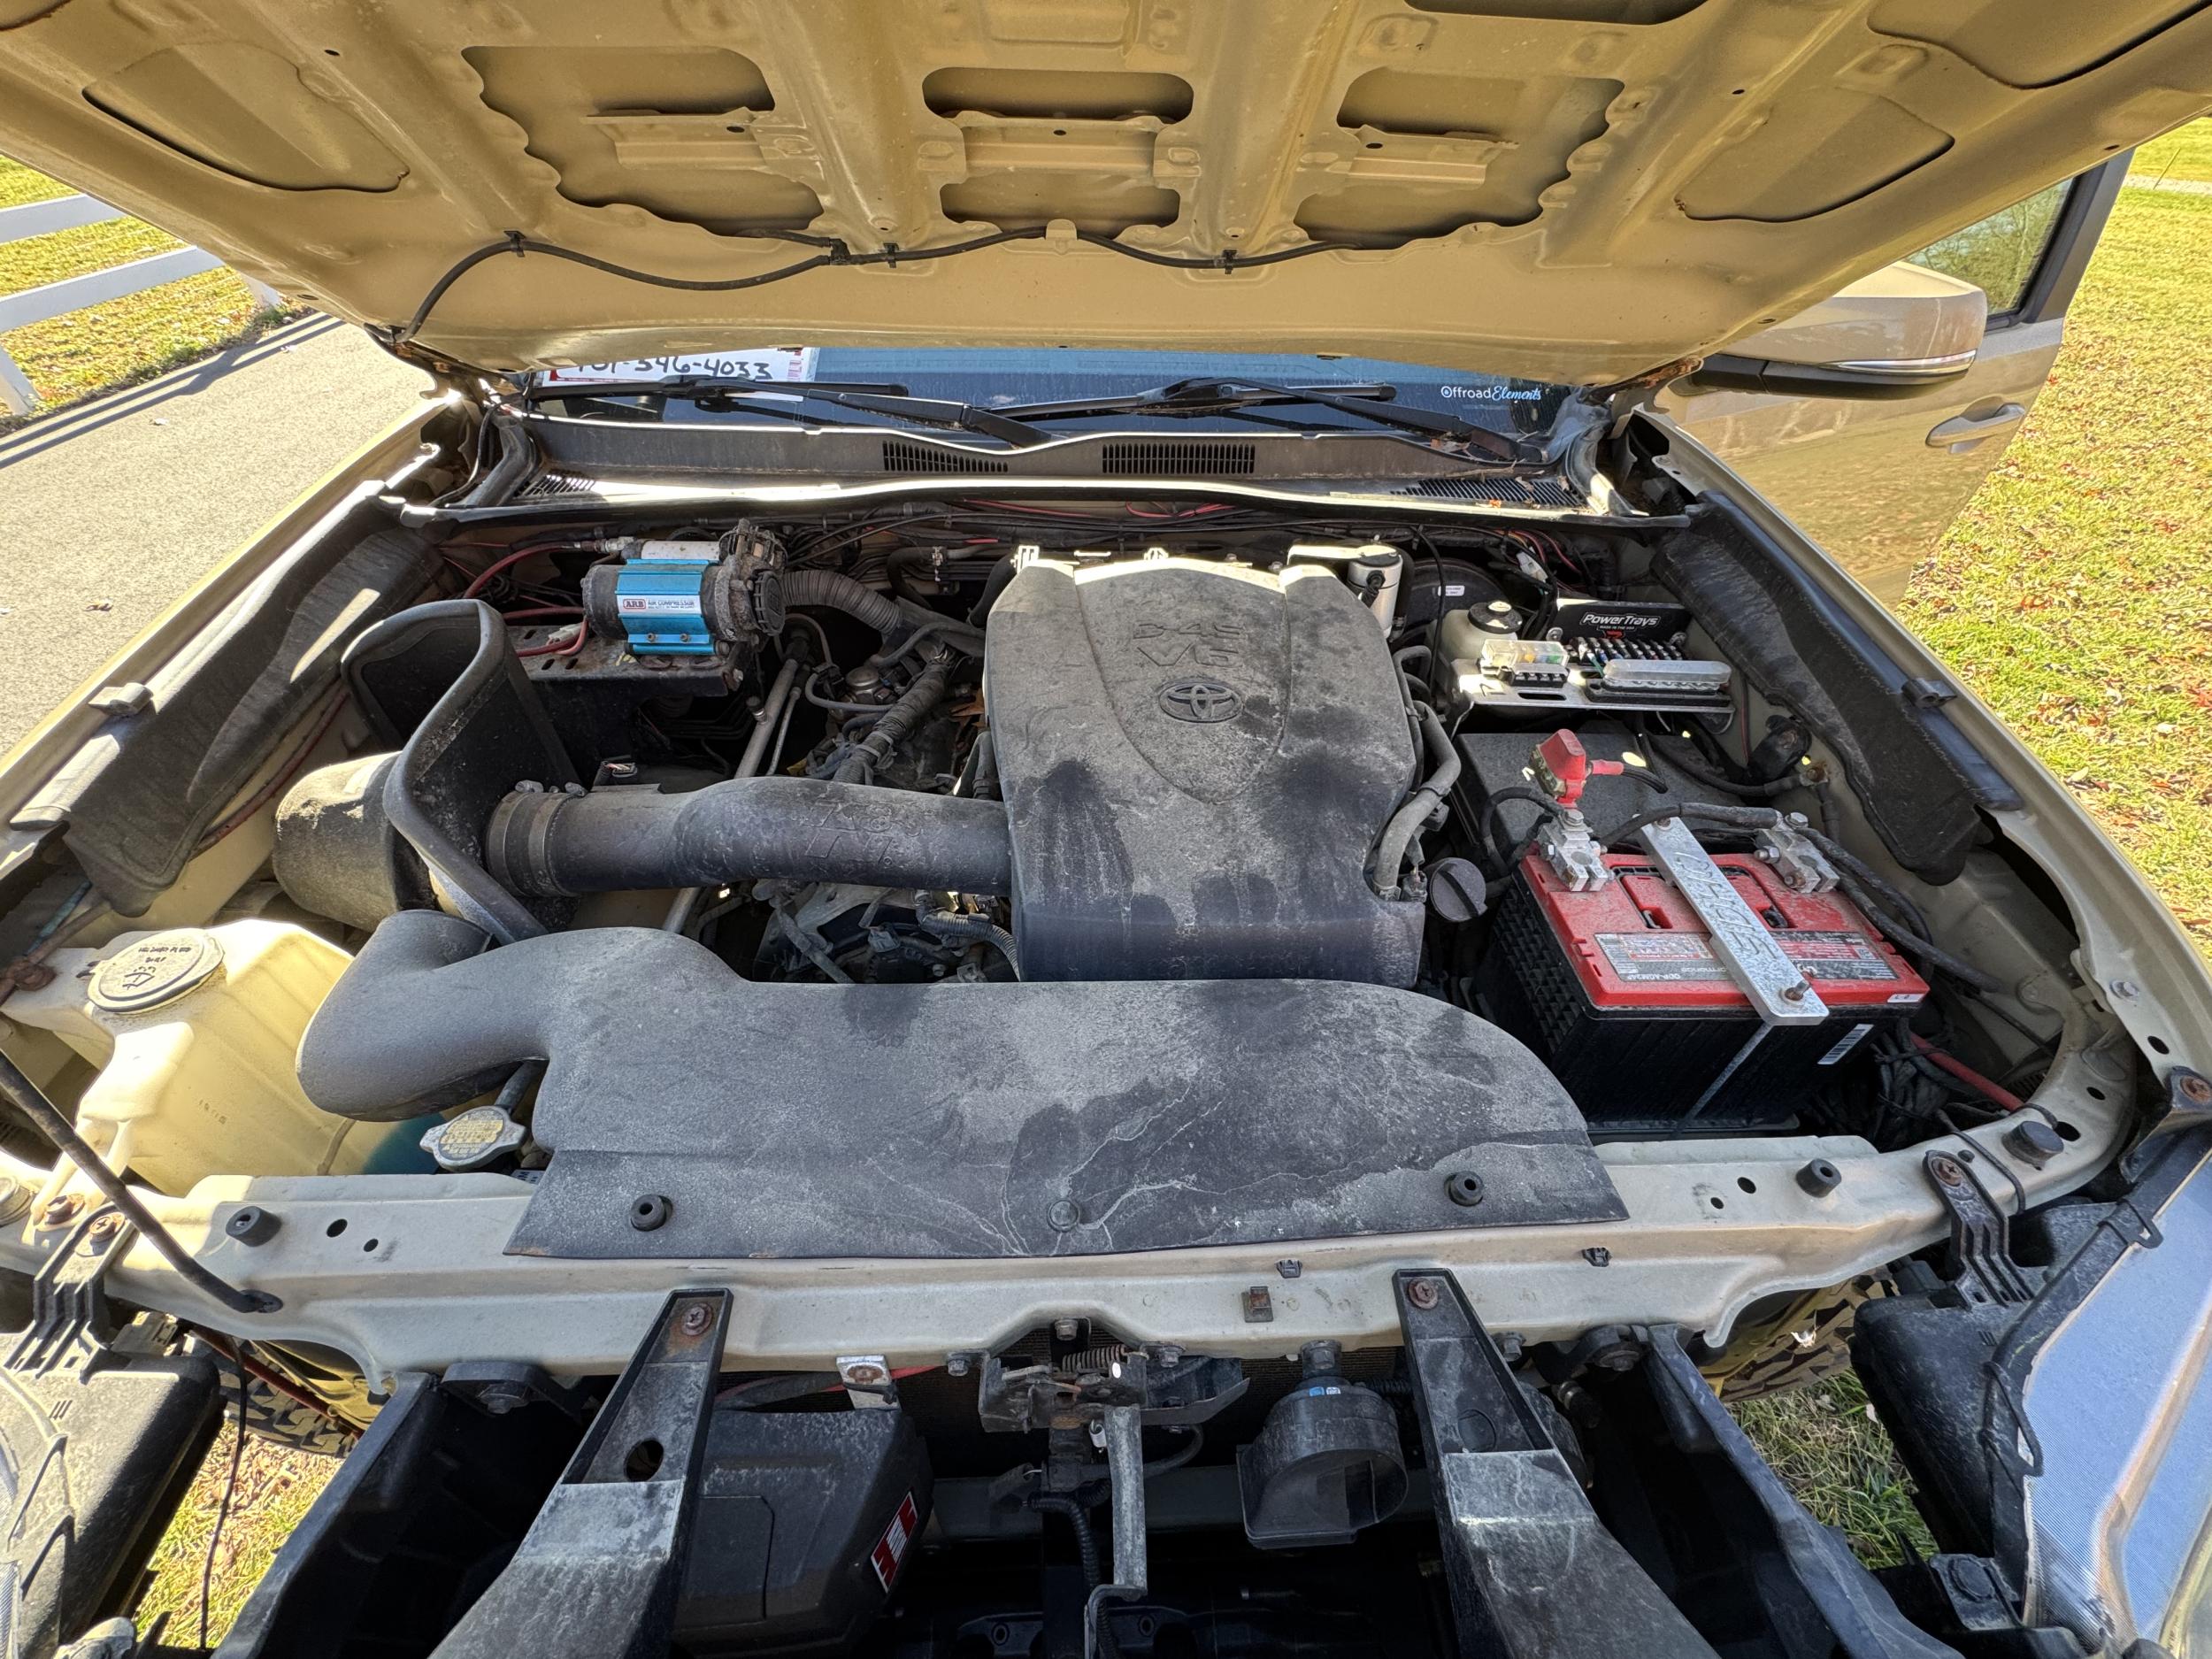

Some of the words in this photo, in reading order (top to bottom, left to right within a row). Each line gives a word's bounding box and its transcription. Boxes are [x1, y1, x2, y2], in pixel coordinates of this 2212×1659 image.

[1133, 620, 1243, 640] D-4S
[1582, 614, 1659, 626] PowerTrays
[1134, 640, 1240, 668] V6
